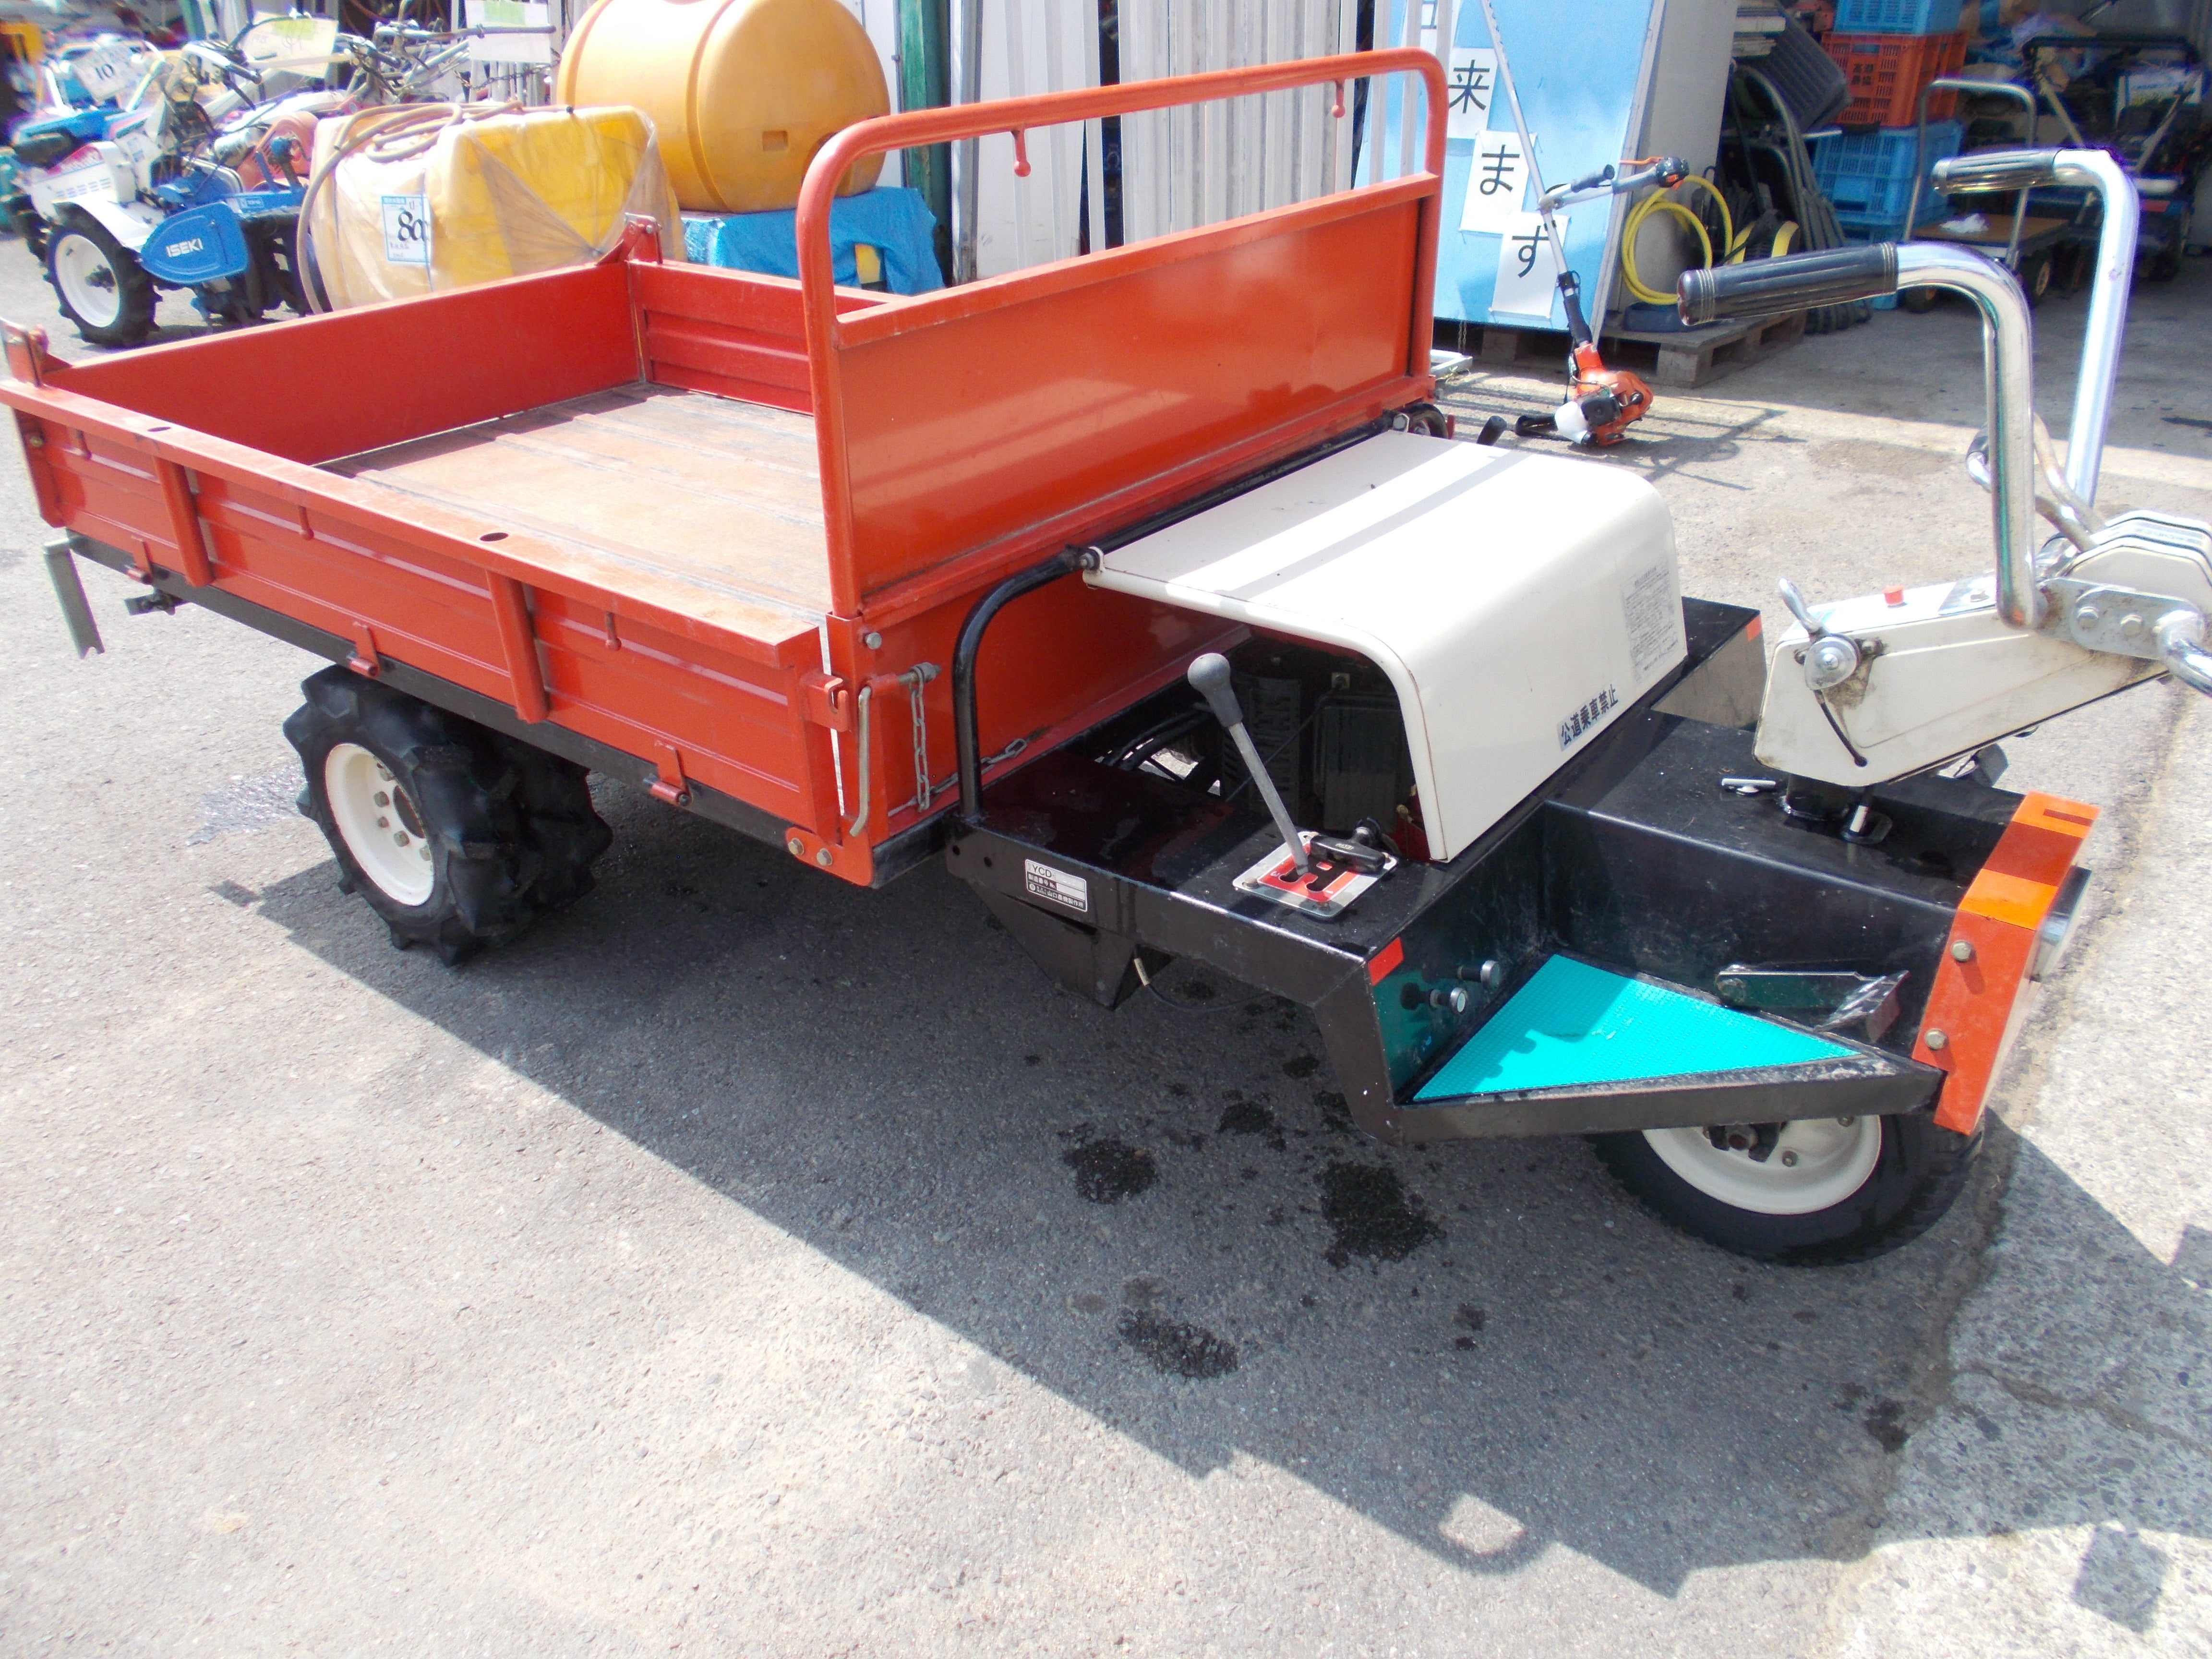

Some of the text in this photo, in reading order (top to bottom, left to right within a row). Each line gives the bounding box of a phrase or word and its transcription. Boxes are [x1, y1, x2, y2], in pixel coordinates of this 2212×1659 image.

[166, 238, 204, 257] ISEKI
[1561, 683, 1619, 746] 公道乗車禁止
